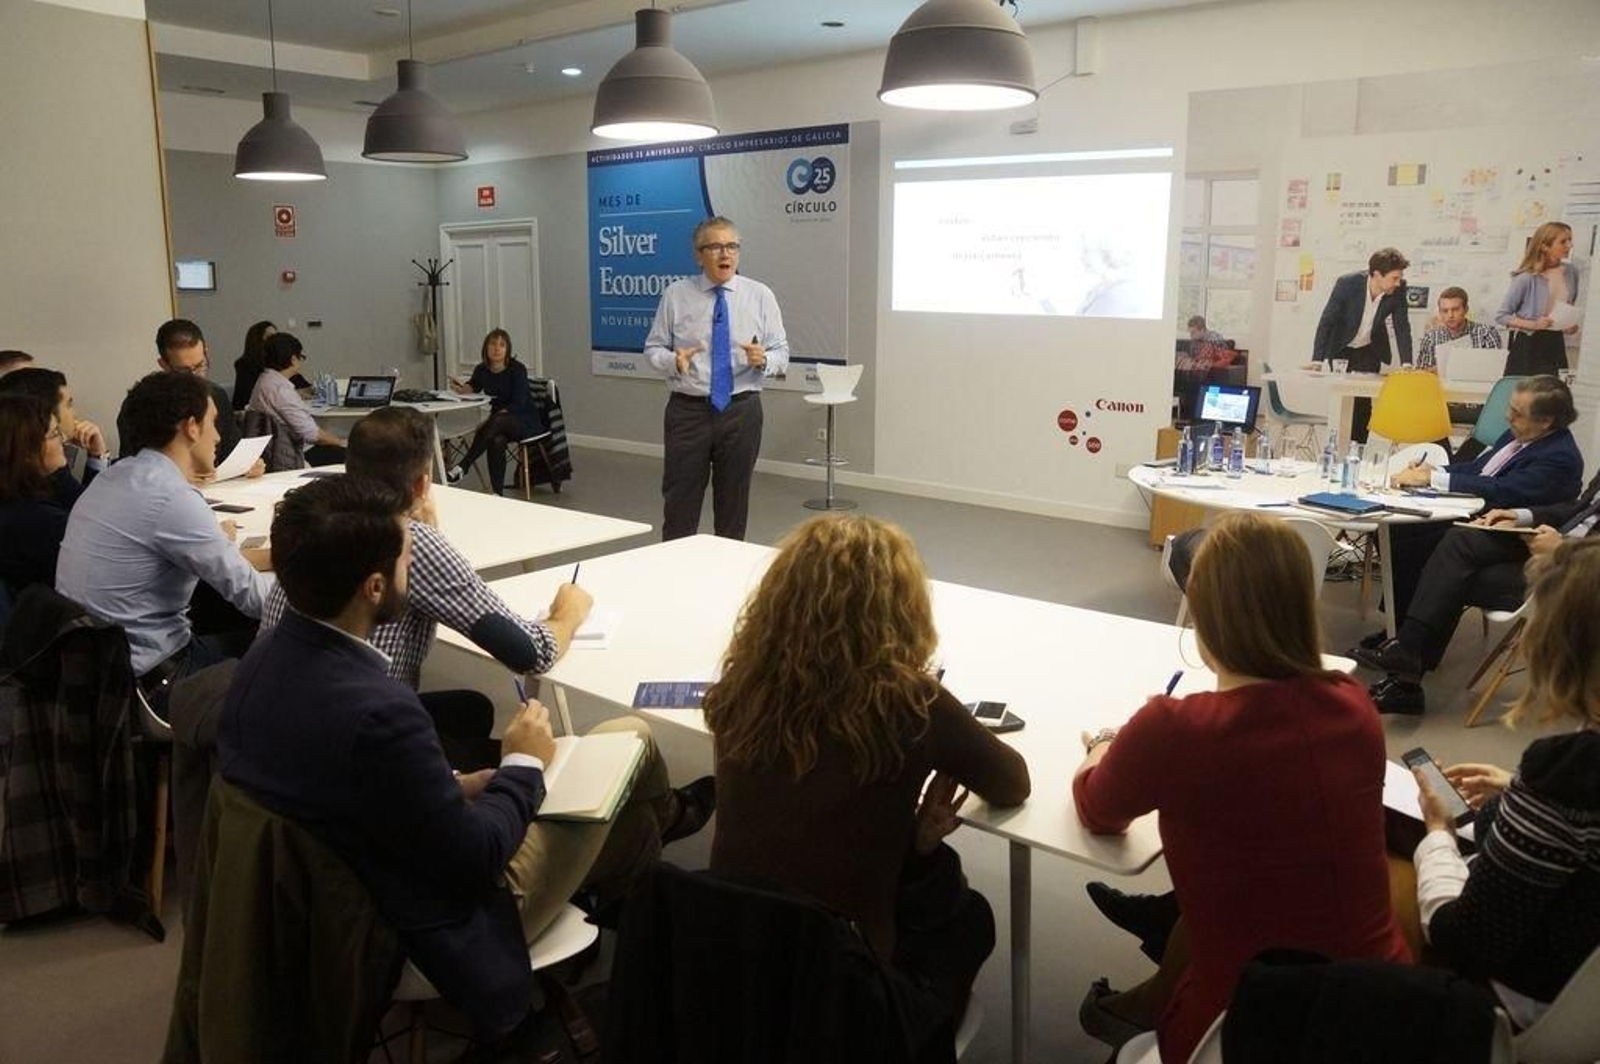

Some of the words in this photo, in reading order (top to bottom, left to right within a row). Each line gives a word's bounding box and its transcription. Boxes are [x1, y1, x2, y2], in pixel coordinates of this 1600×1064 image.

[645, 145, 694, 158] ANIVERSARIO
[733, 134, 788, 149] EMPRESARIOS
[791, 133, 804, 143] DE
[805, 130, 842, 142] GALICIA
[813, 167, 831, 185] 25
[599, 195, 622, 208] MES
[626, 193, 642, 206] DE
[785, 199, 837, 214] CÍRCULO
[599, 224, 658, 256] Silver
[599, 265, 687, 296] Econo
[600, 314, 654, 327] NOVIEMB
[1095, 398, 1144, 413] Canon
